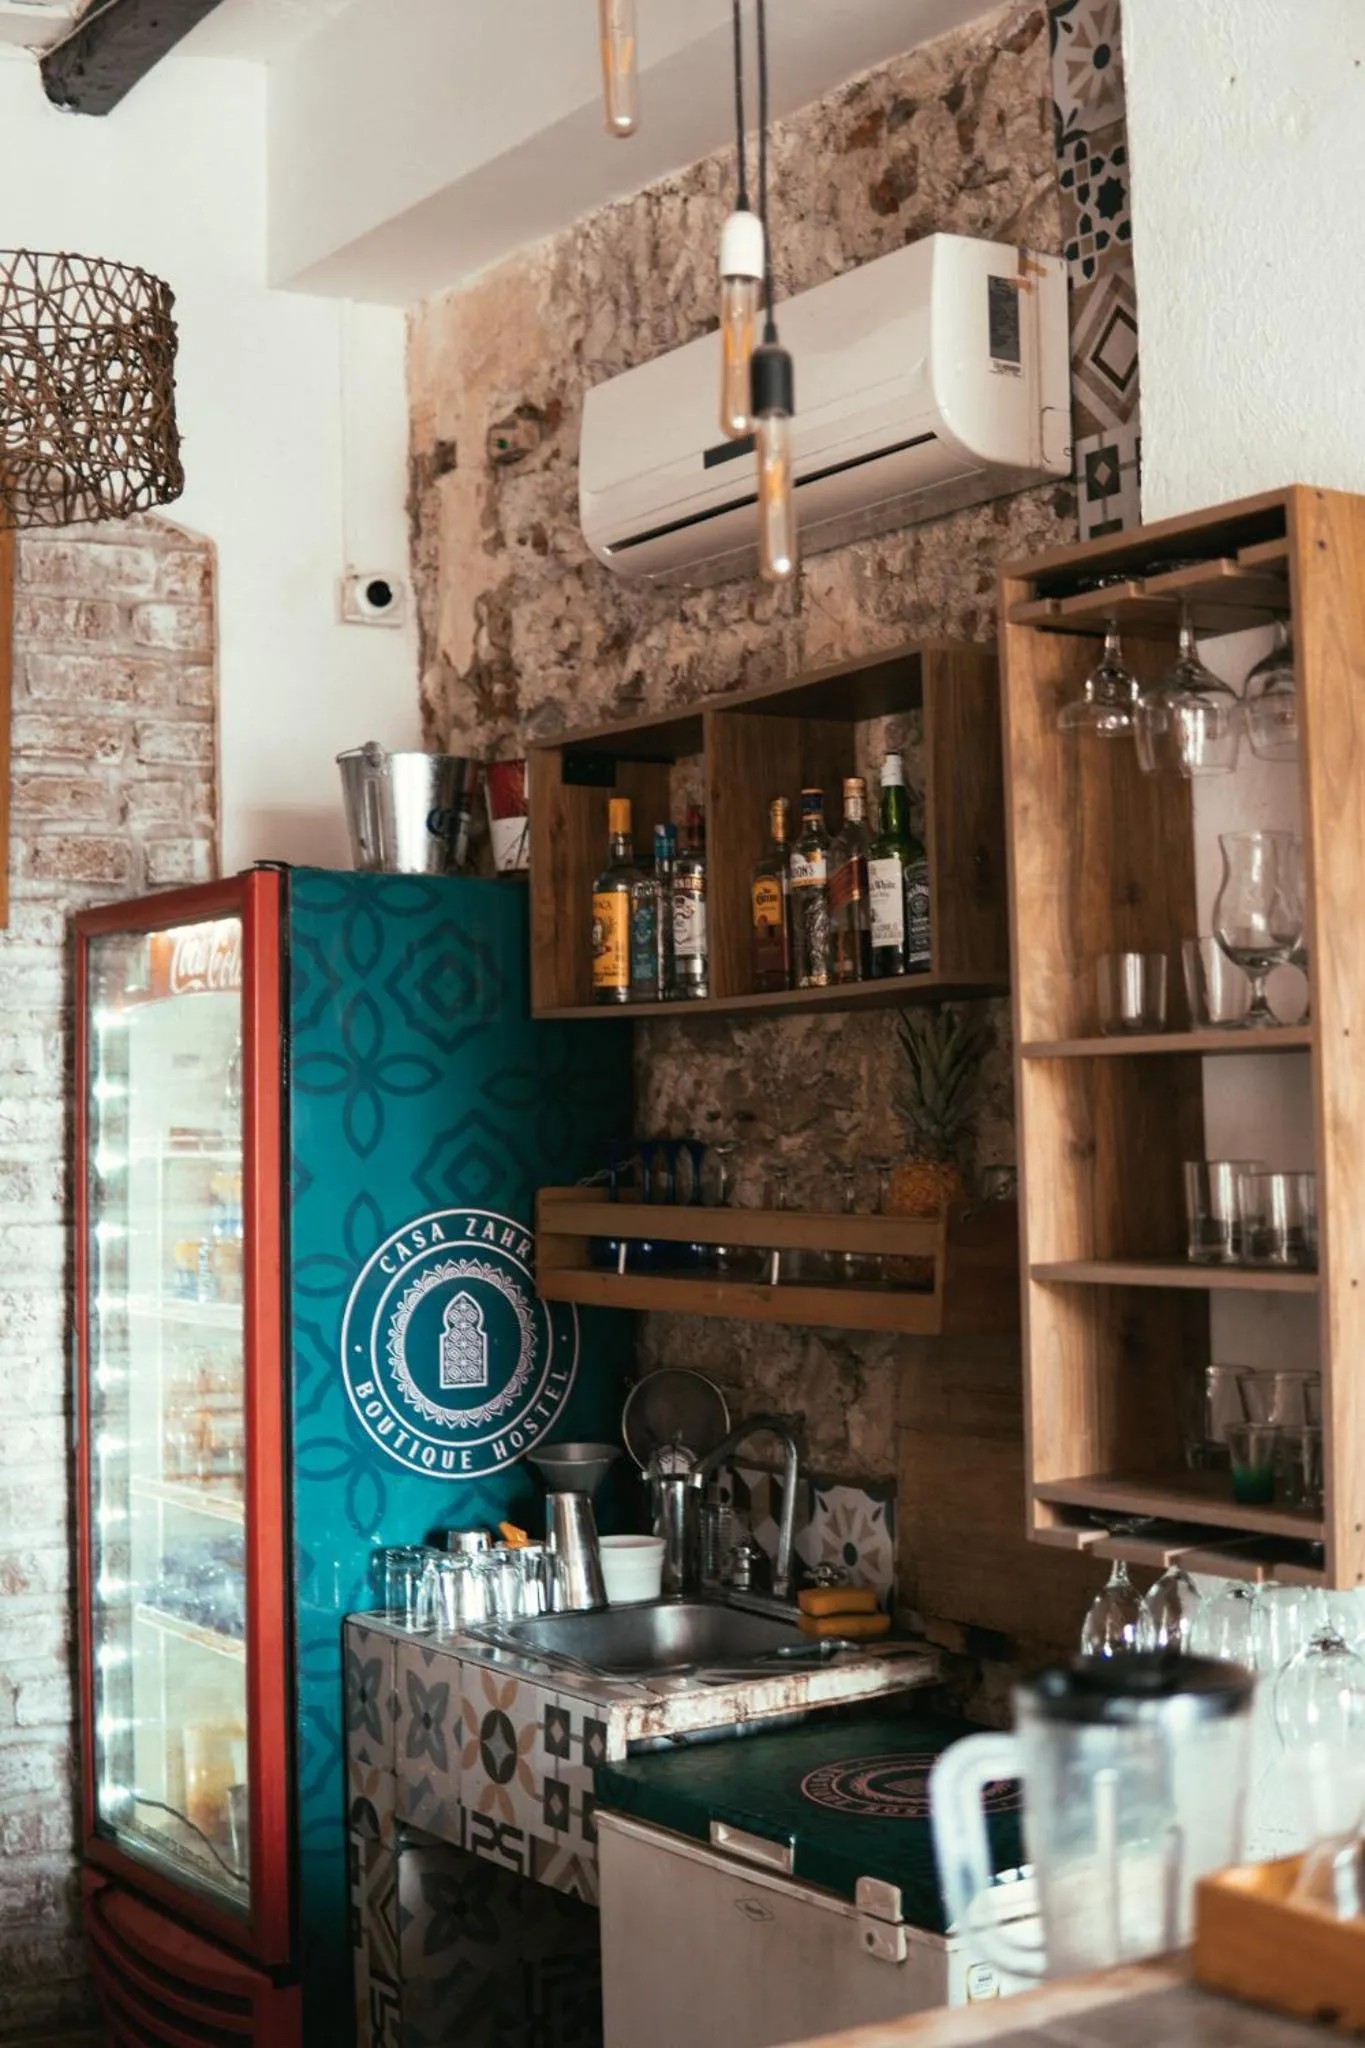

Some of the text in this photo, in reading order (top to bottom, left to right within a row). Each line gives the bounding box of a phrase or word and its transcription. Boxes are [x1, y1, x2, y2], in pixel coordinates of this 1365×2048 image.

[379, 1217, 535, 1274] CASA ZAHR
[355, 1370, 569, 1470] BOUTIQUE HOSTEL
